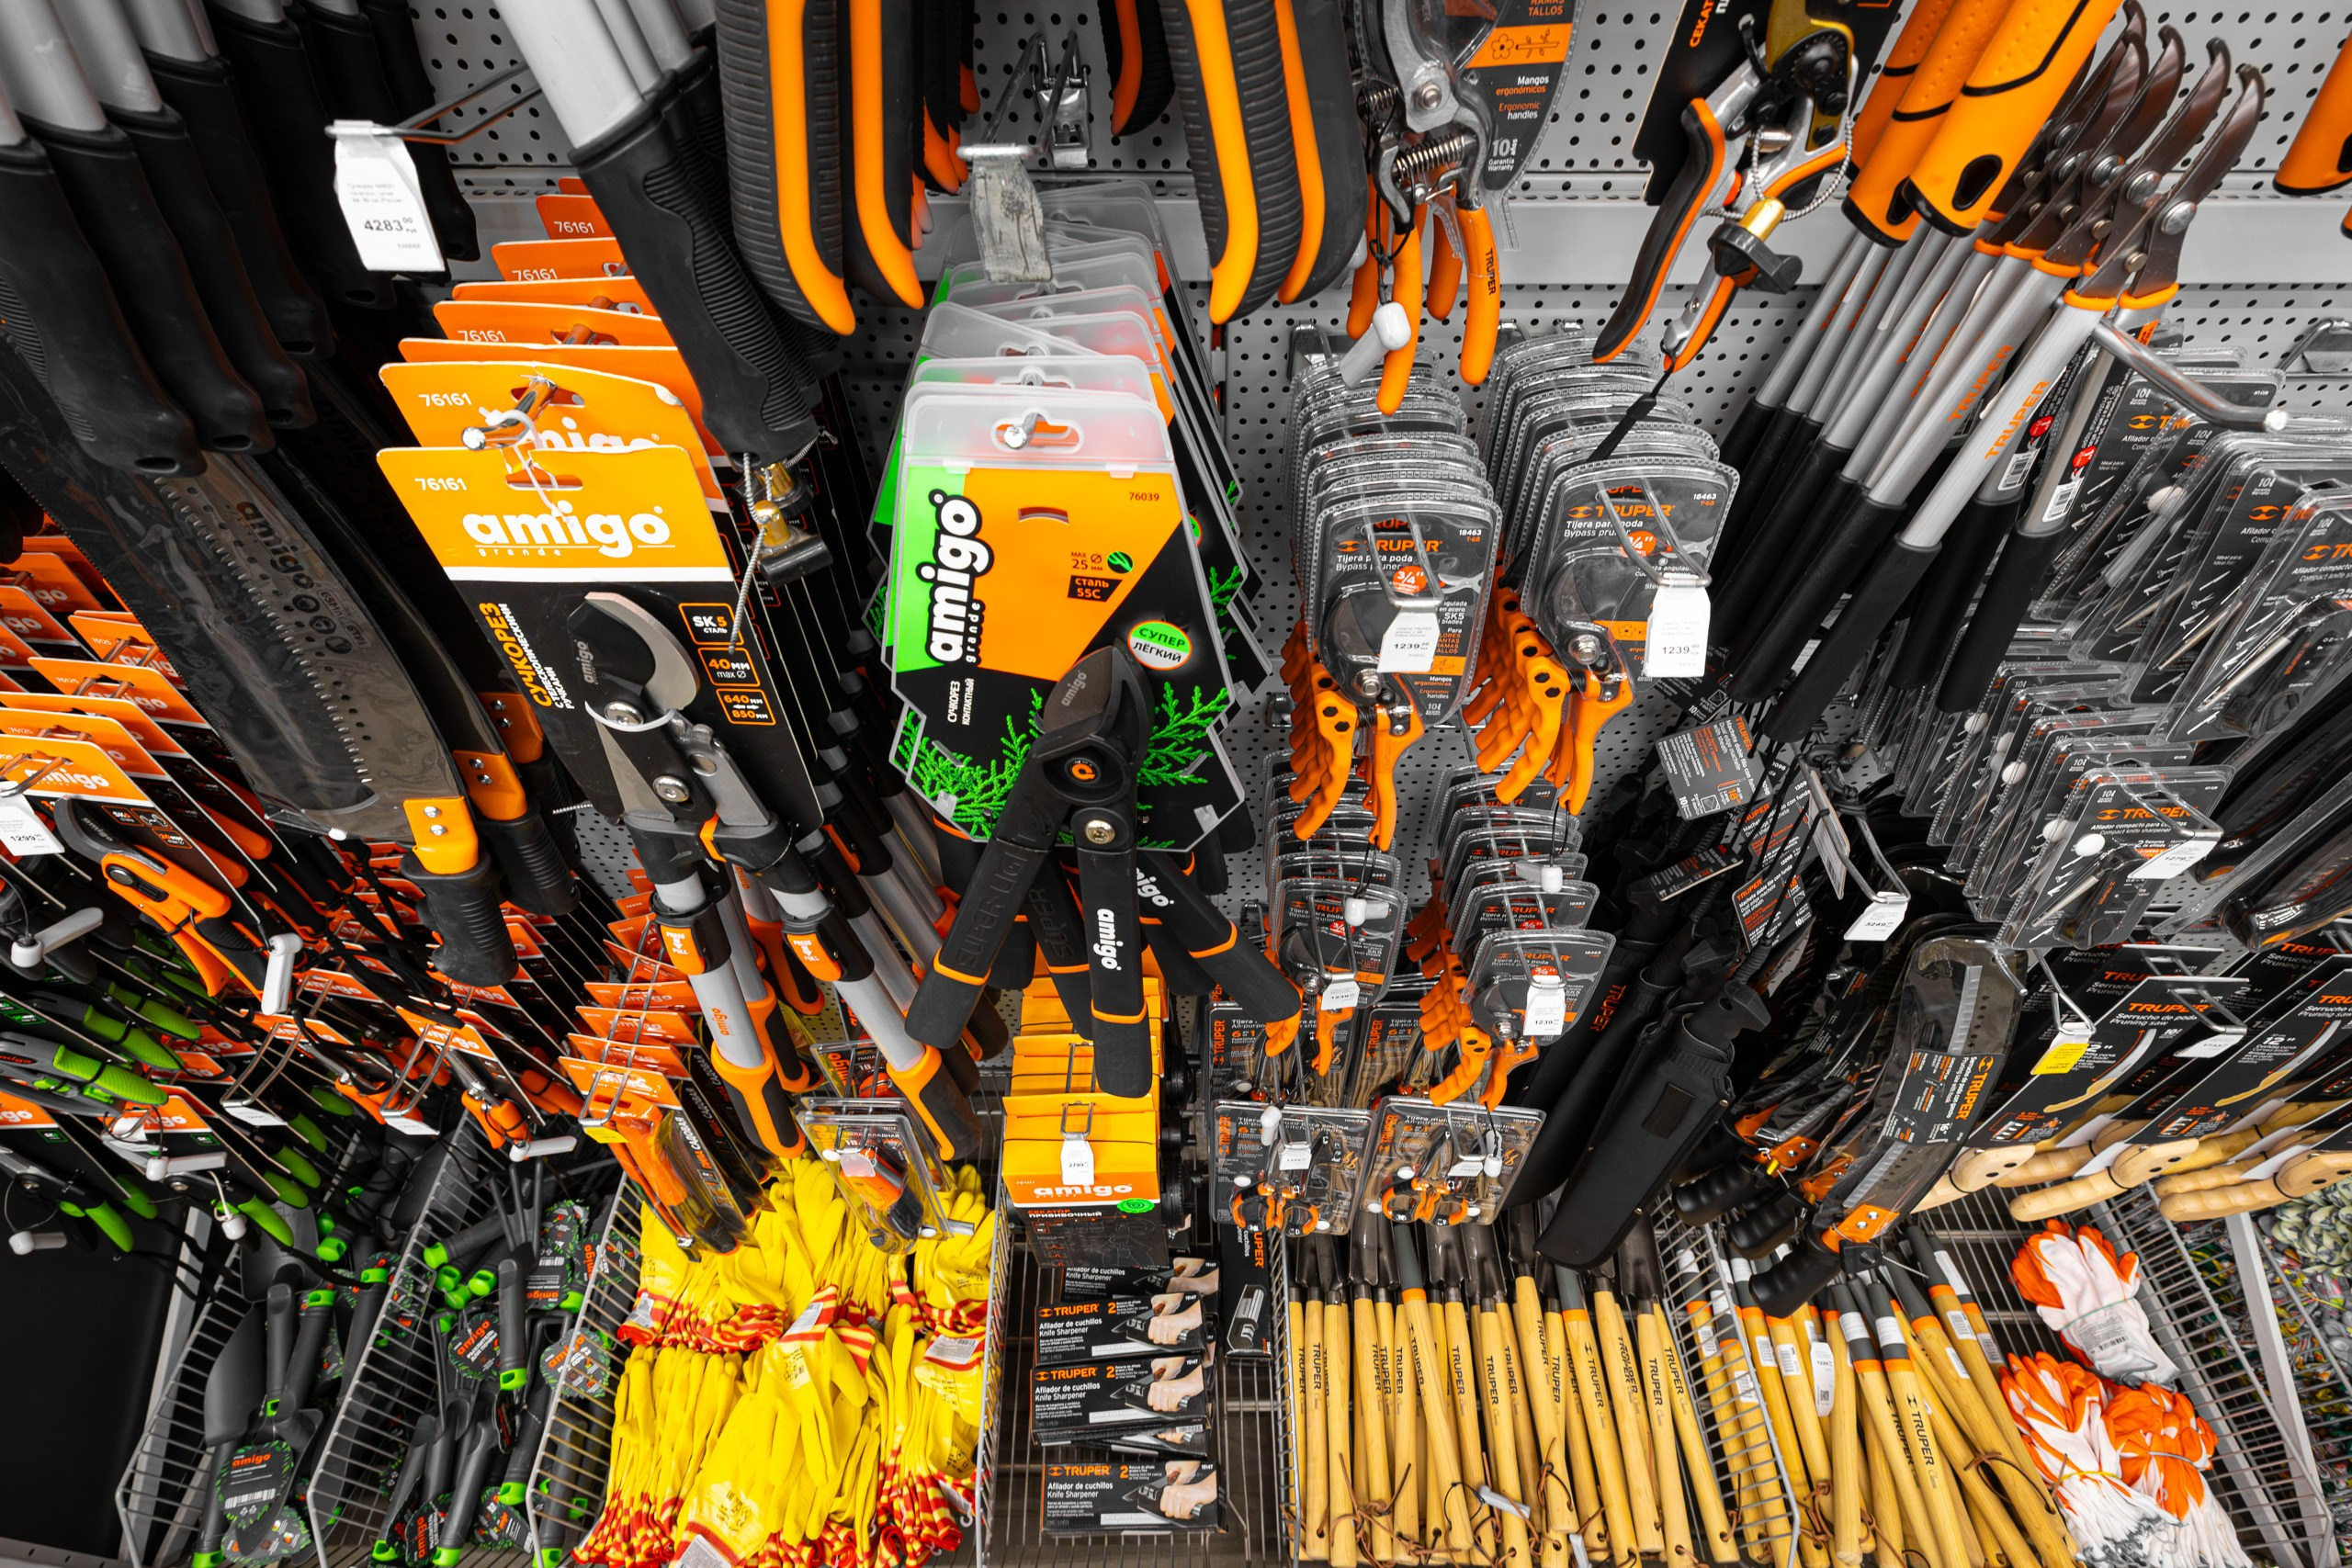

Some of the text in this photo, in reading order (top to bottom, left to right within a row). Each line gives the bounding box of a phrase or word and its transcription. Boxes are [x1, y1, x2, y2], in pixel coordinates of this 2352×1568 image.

[1528, 6, 1564, 17] TALLOS
[1517, 75, 1549, 86] Mangos
[1496, 85, 1547, 96] ergonómicos
[1498, 101, 1540, 112] Ergonomic
[1507, 110, 1538, 120] handles
[1492, 140, 1510, 157] 10
[364, 219, 402, 231] 4283
[554, 220, 594, 234] 76161
[512, 267, 558, 281] 76161
[1485, 246, 1497, 296] TRUPER
[458, 330, 506, 343] 76161
[1947, 344, 2015, 423] TRUPER
[418, 393, 472, 407] 76161
[1984, 380, 2051, 460] TRUPER
[414, 478, 468, 491] 76161
[1128, 492, 1159, 502] 76039
[462, 499, 671, 558] amigo
[1564, 529, 1596, 537] Bypass
[1566, 520, 1593, 529] Tijera
[236, 502, 314, 589] amigo
[478, 548, 562, 557] grande
[1072, 559, 1088, 570] 25
[1336, 562, 1368, 571] Bypass
[1337, 554, 1413, 564] Tijera poda
[2291, 565, 2316, 575] Afilador
[921, 499, 989, 662] amigo
[1075, 577, 1109, 588] сталь
[693, 615, 728, 628] SK 5
[1443, 612, 1465, 621] SK5
[703, 626, 728, 635] СТАЛЬ
[966, 603, 980, 663] grande
[1138, 627, 1186, 648] СУПЕР
[479, 603, 552, 707] СУЧКОРЕЗ
[1133, 641, 1182, 663] ЛЁГКИЙ
[1662, 646, 1690, 655] 1239
[576, 640, 595, 685] amigo
[717, 671, 735, 680] max
[1061, 672, 1087, 706] amigo
[947, 681, 960, 723] СУЧКОРЕЗ
[962, 677, 975, 726] КОНТАКТНЫЙ
[1725, 720, 1737, 743] Machete
[1735, 716, 1753, 751] TRUPER
[10, 835, 35, 843] 1299
[1736, 878, 1763, 901] TRUPER
[1739, 892, 1756, 908] Machete
[1092, 908, 1124, 972] amigo
[1590, 985, 1626, 1031] TRUPER
[2116, 1012, 2159, 1021] Serrucho
[711, 1007, 730, 1037] amigo
[2109, 1018, 2146, 1026] Pruning
[1214, 1020, 1226, 1053] TRUPER
[1369, 1019, 1384, 1053] TRUPER
[1954, 1072, 1988, 1121] TRUPER
[1219, 1116, 1231, 1148] TRUPER
[1381, 1114, 1399, 1145] TRUPER
[1034, 1184, 1132, 1197] amigo
[1100, 1268, 1125, 1276] cuchillos
[526, 1291, 560, 1301] amigo
[1054, 1303, 1100, 1316] TRUPER
[1107, 1302, 1116, 1314] 2
[1039, 1320, 1065, 1329] Afilador
[1075, 1318, 1102, 1327] cuchillos
[1039, 1325, 1089, 1337] Knife Sharpener
[457, 1319, 492, 1357] amigo
[1536, 1319, 1549, 1366] TRUPER
[1313, 1342, 1321, 1390] TRUPER
[1372, 1342, 1382, 1391] TRUPER
[1379, 1346, 1391, 1394] TRUPER
[1410, 1337, 1425, 1386] TRUPER
[1504, 1346, 1518, 1394] TRUPER
[1050, 1367, 1098, 1381] TRUPER
[1106, 1365, 1114, 1379] 2
[1452, 1346, 1465, 1395] TRUPER
[1665, 1347, 1684, 1395] TRUPER
[1035, 1382, 1101, 1394] Afilador de cuchillos
[1486, 1355, 1499, 1404] TRUPER
[1552, 1356, 1560, 1404] TRUPER
[1588, 1359, 1604, 1408] TRUPER
[1649, 1358, 1663, 1405] TRUPER
[1035, 1391, 1086, 1402] Knife Sharpener
[1892, 1413, 1915, 1466] TRUPER
[1912, 1412, 1935, 1466] TRUPER
[232, 1452, 272, 1469] amigo
[1063, 1465, 1111, 1476] TRUPER
[1120, 1465, 1128, 1479] 2
[1047, 1482, 1114, 1491] Afilador de cuchillos
[1047, 1491, 1099, 1499] Knife Sharpener
[416, 1516, 427, 1559] amigo
